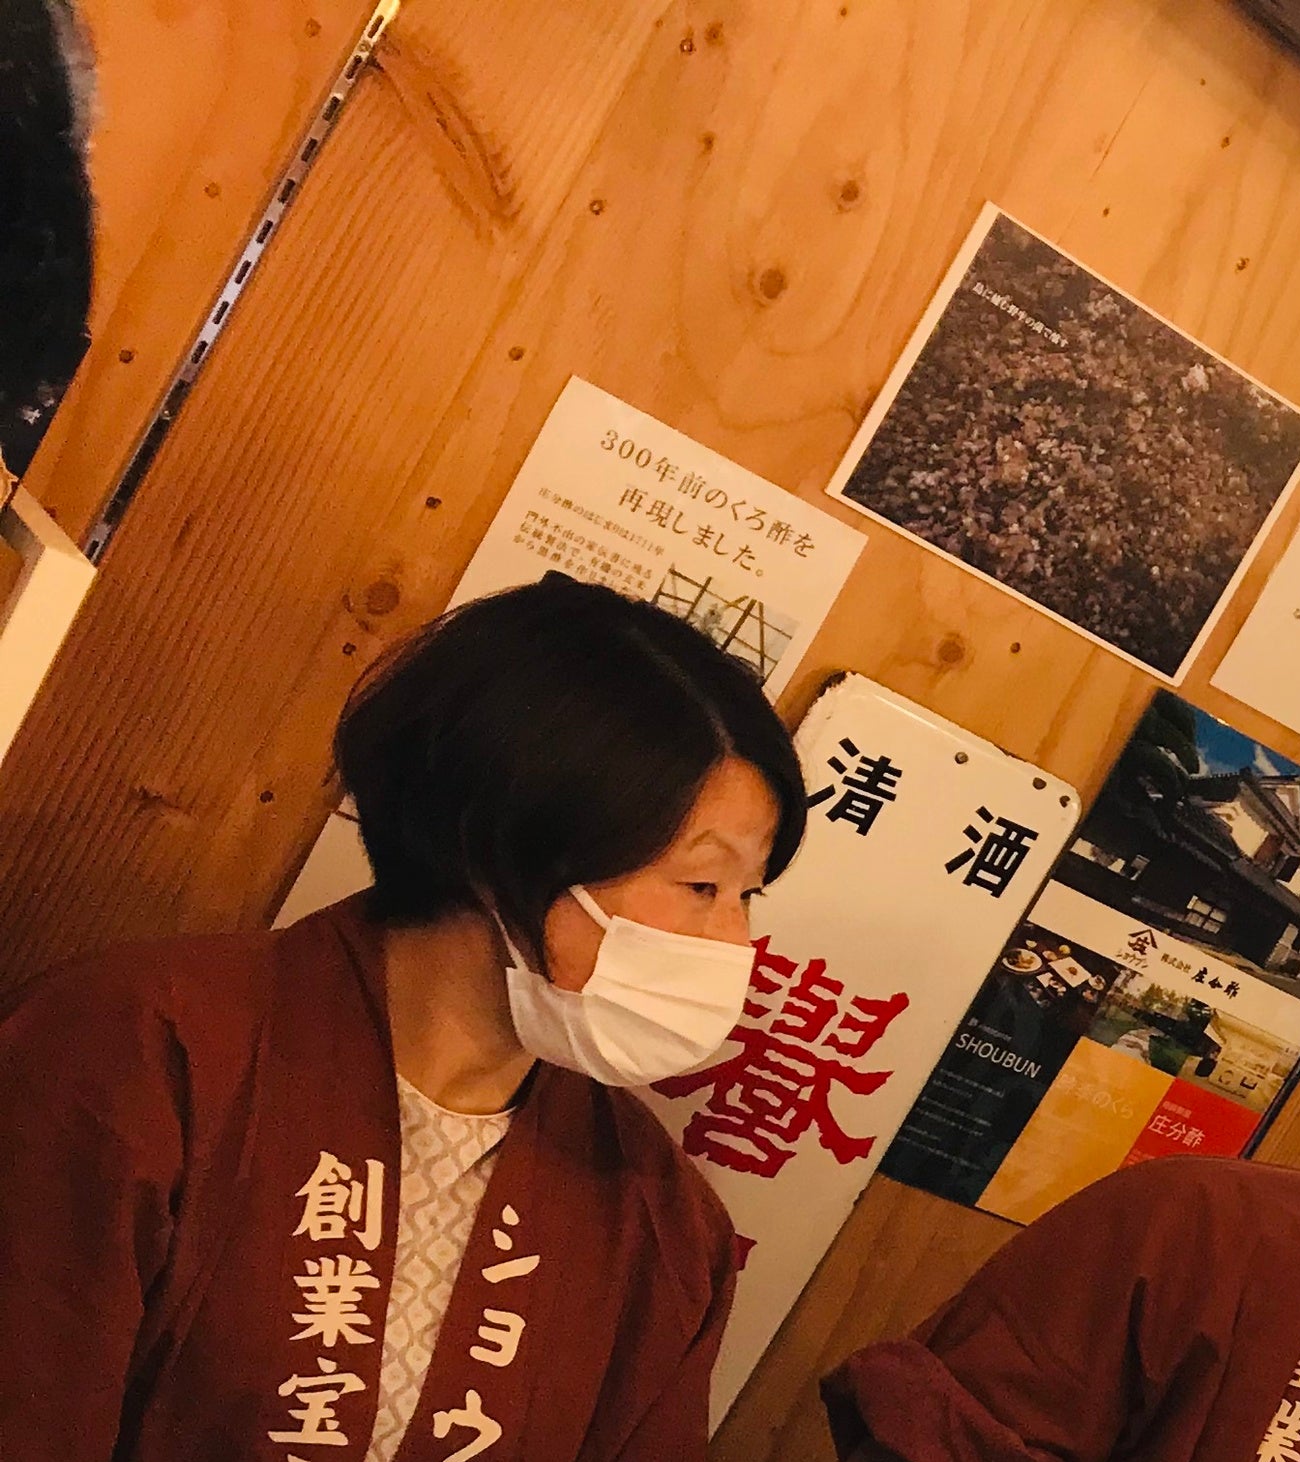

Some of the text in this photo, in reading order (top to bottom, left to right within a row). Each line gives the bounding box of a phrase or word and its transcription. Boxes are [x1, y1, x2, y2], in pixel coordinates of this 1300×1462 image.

[596, 427, 819, 560] 300年前のくろ酢を
[616, 482, 771, 580] 再現しました。
[1190, 965, 1242, 1000] 庄分酢
[954, 1030, 1041, 1079] SHOUBUN
[1147, 1113, 1206, 1150] 庄分酢
